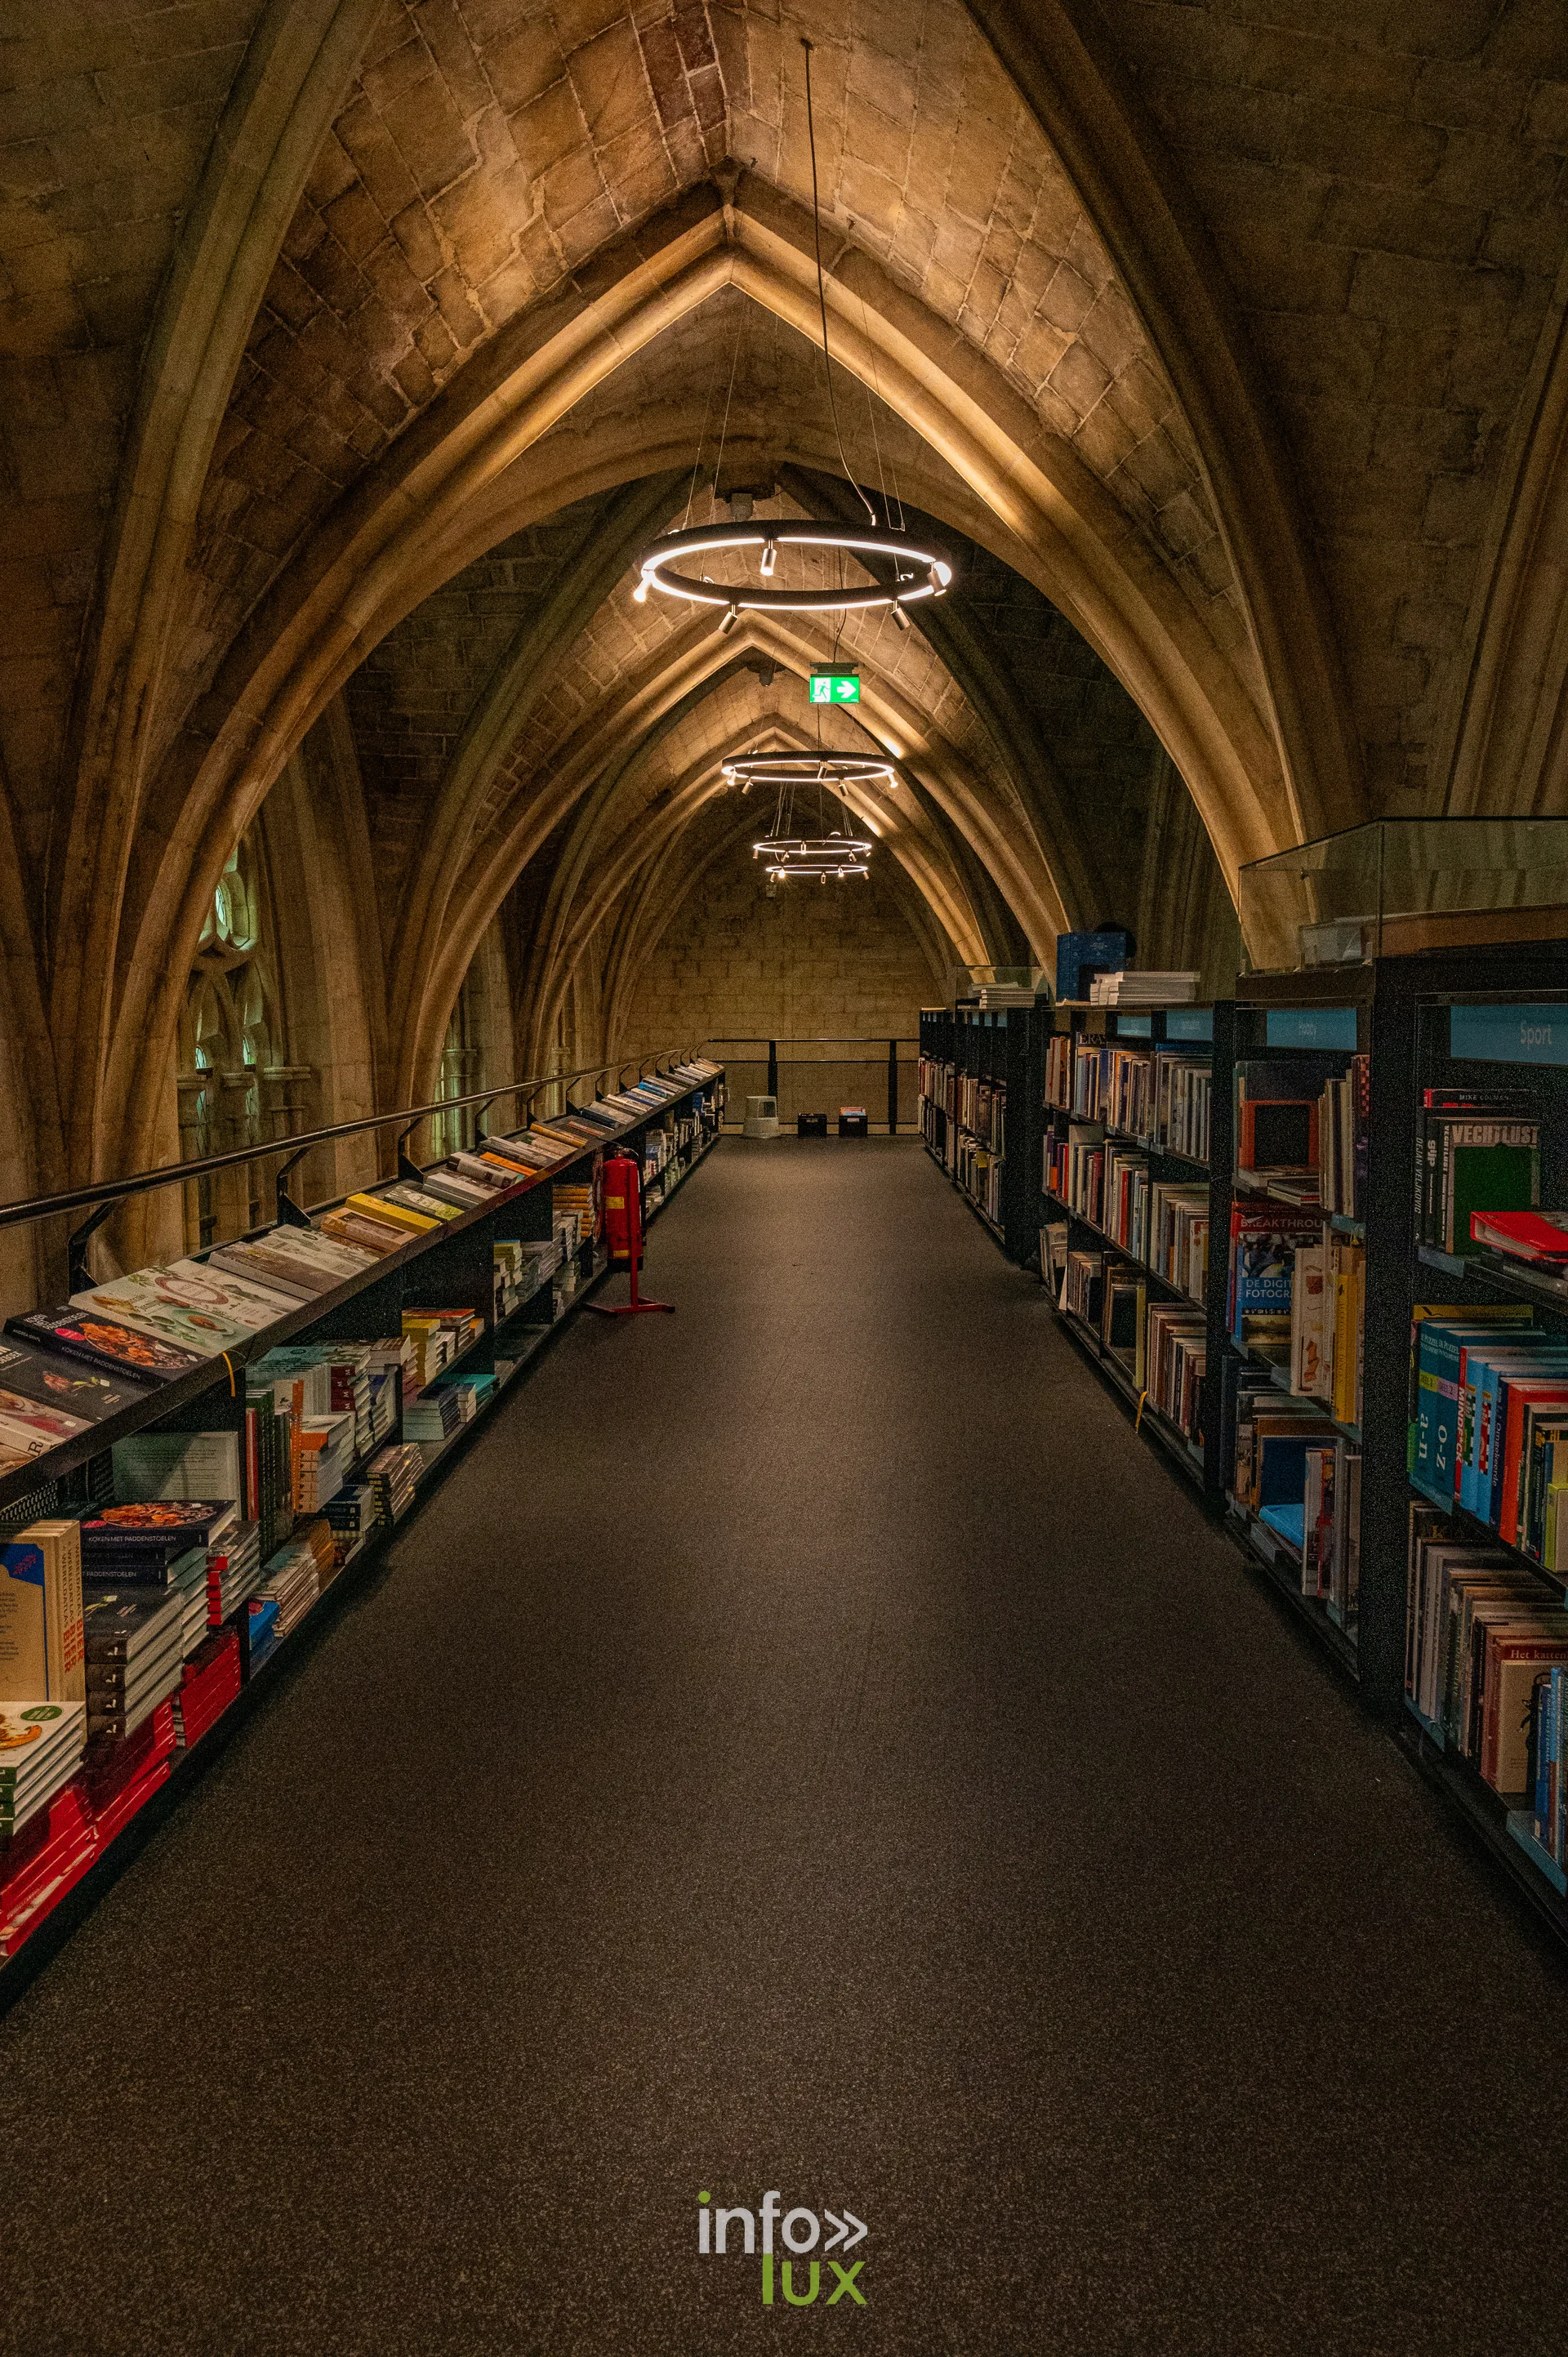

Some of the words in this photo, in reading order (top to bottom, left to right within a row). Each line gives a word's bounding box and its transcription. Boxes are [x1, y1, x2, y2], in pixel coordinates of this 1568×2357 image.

[1520, 1020, 1552, 1048] Sport
[1451, 1125, 1539, 1144] VECHTLUST
[1415, 1137, 1423, 1165] DEJAN
[1245, 1279, 1260, 1288] DE
[61, 1345, 83, 1359] KOKEN
[93, 1357, 141, 1381] PADDENSTOELEN
[64, 1629, 72, 1673] BIER
[76, 1619, 84, 1663] BIER
[1511, 1649, 1530, 1659] Het
[1534, 1649, 1568, 1659] katten
